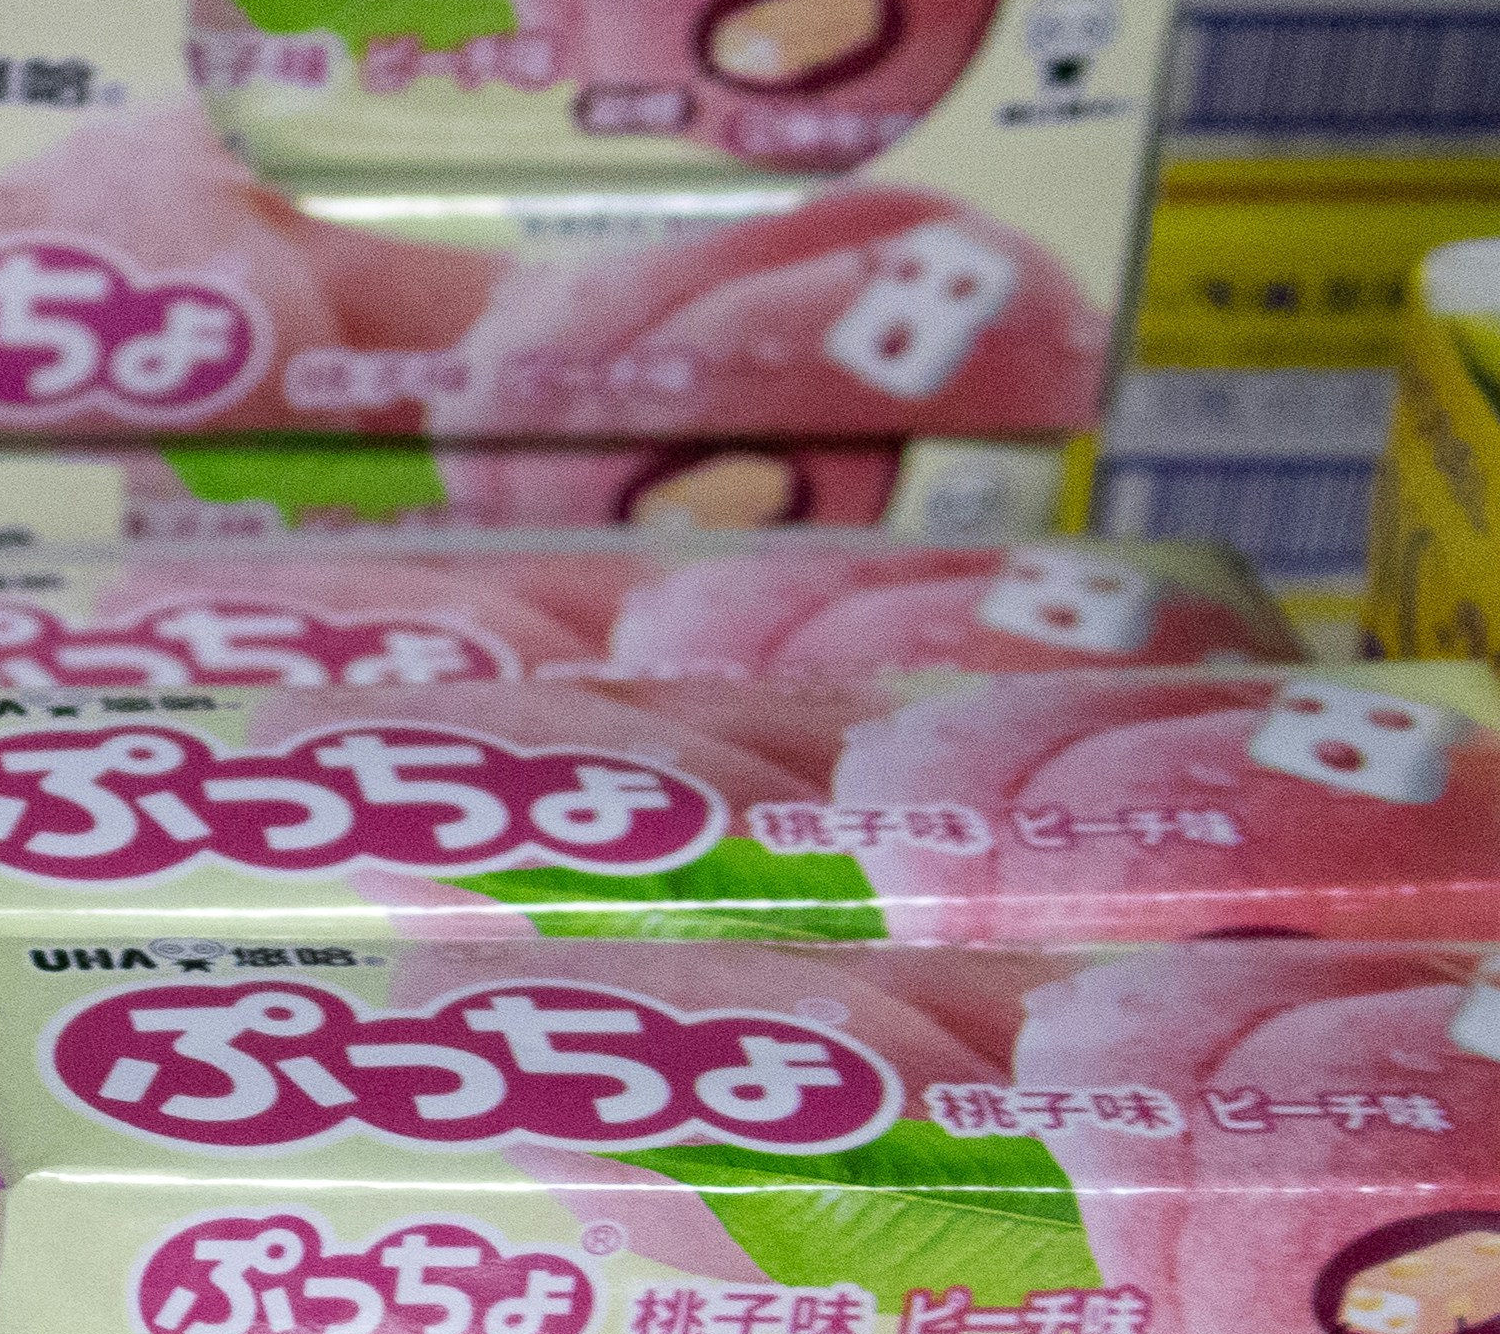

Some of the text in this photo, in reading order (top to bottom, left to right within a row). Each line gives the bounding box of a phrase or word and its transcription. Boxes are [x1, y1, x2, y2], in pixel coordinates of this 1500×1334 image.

[754, 807, 1244, 847] 桃子味 ピーチ味
[32, 946, 155, 971] UHA
[100, 990, 842, 1124] ぷっちょ
[934, 1089, 1451, 1133] 桃子味 ピーチ味
